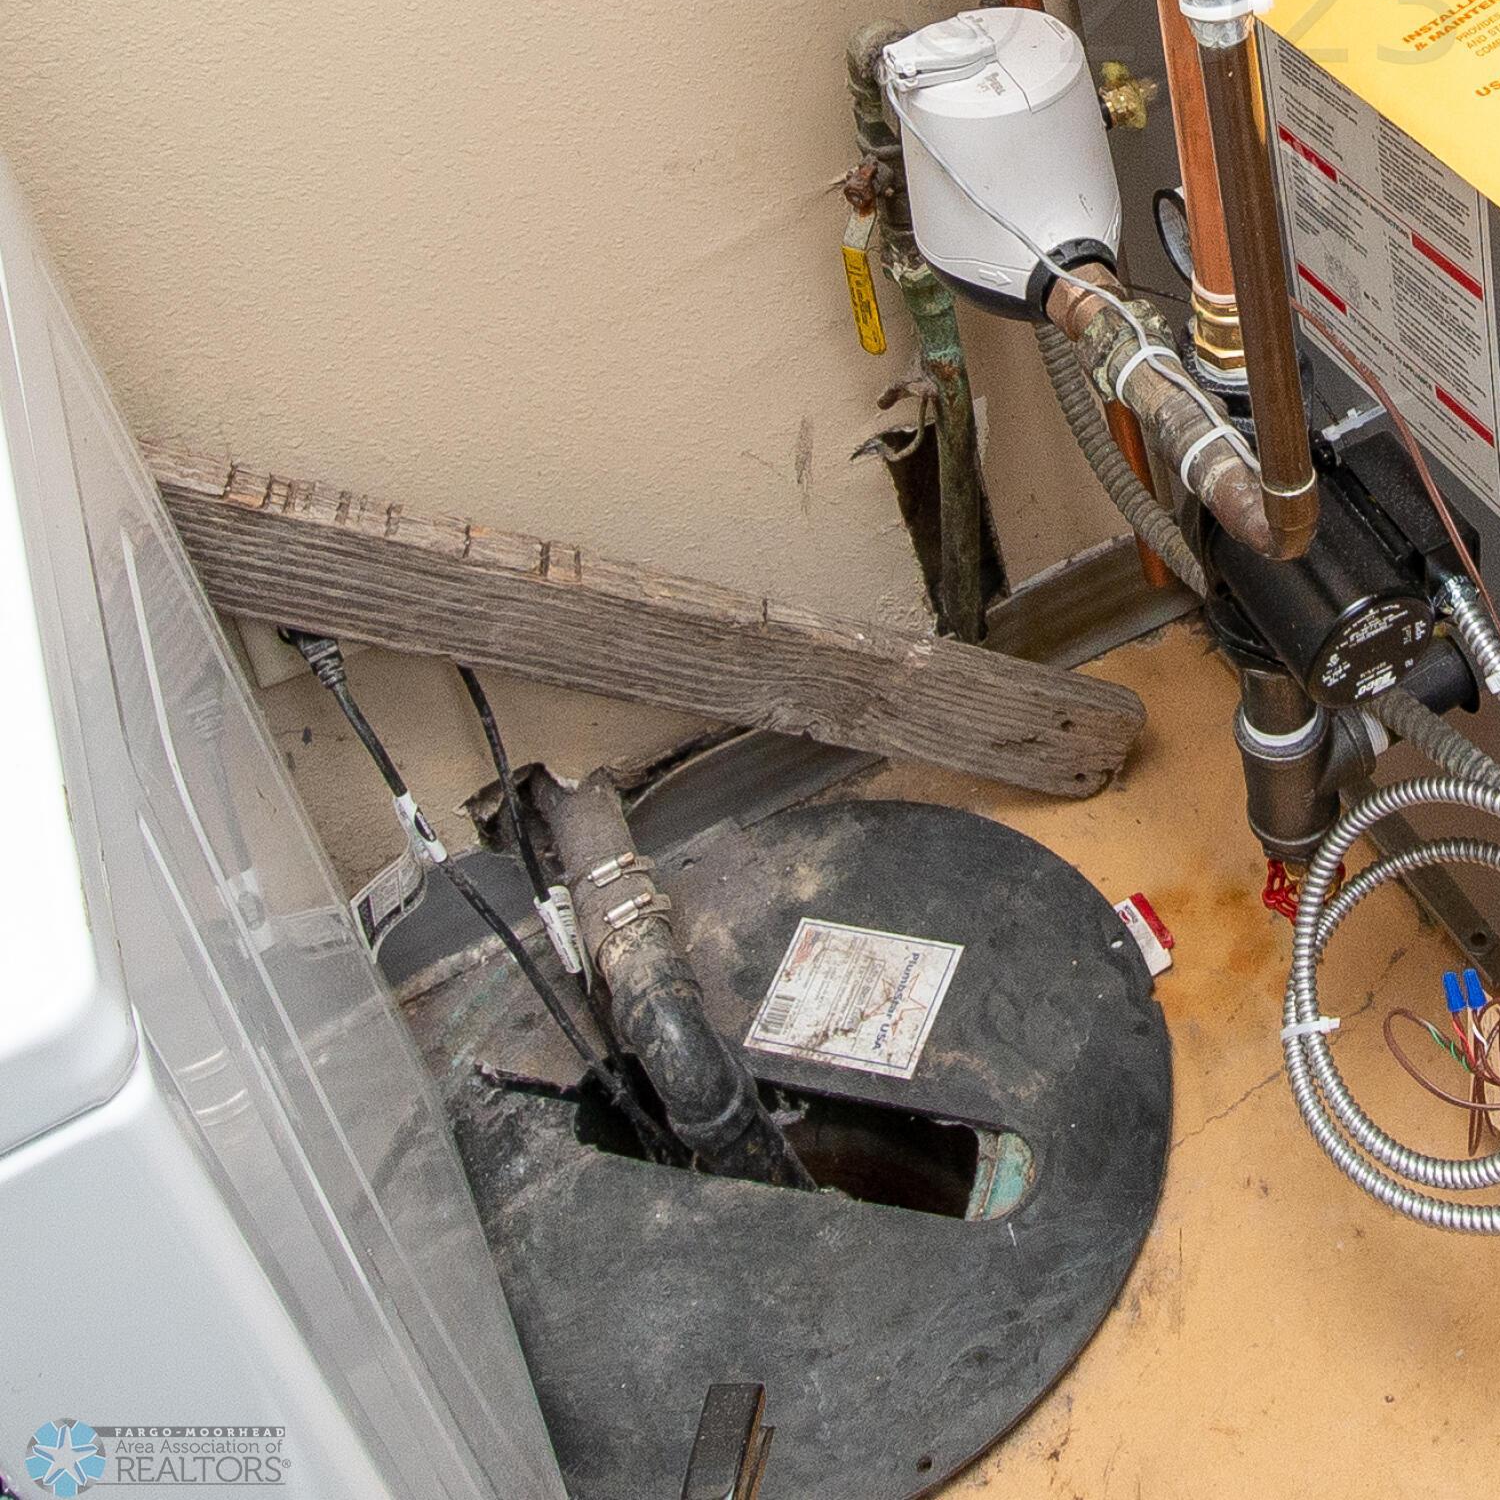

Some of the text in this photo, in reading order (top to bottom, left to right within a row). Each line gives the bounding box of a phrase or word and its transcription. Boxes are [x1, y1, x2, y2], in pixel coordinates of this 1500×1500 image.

[1412, 39, 1428, 51] &
[1464, 33, 1488, 49] AND
[872, 951, 920, 1051] PlumbStar USA
